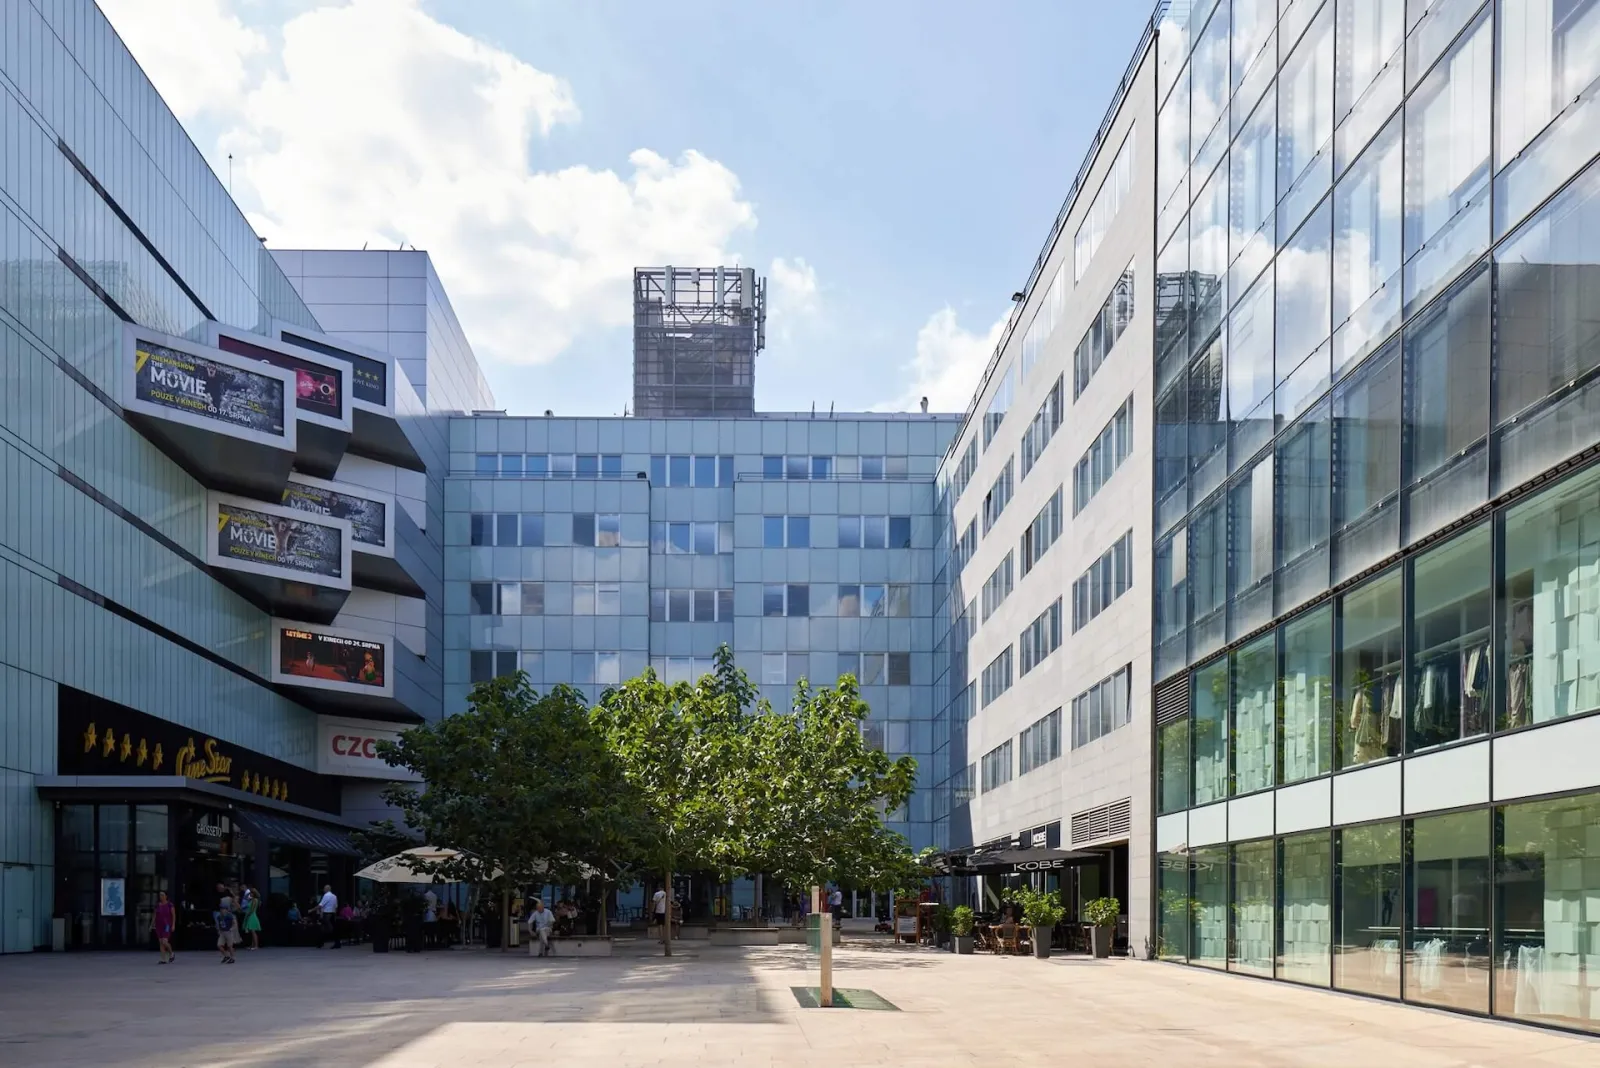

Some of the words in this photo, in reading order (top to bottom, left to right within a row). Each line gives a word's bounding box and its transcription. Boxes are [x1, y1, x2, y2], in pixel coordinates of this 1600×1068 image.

[151, 360, 164, 369] THE
[150, 366, 208, 397] MOVIE
[150, 389, 175, 402] POUZE
[181, 397, 207, 411] KINECH
[207, 405, 218, 414] OD
[228, 410, 252, 423] SRPNA
[230, 525, 276, 550] MOVIE
[332, 735, 378, 759] CZC
[1013, 859, 1065, 872] KOBE
